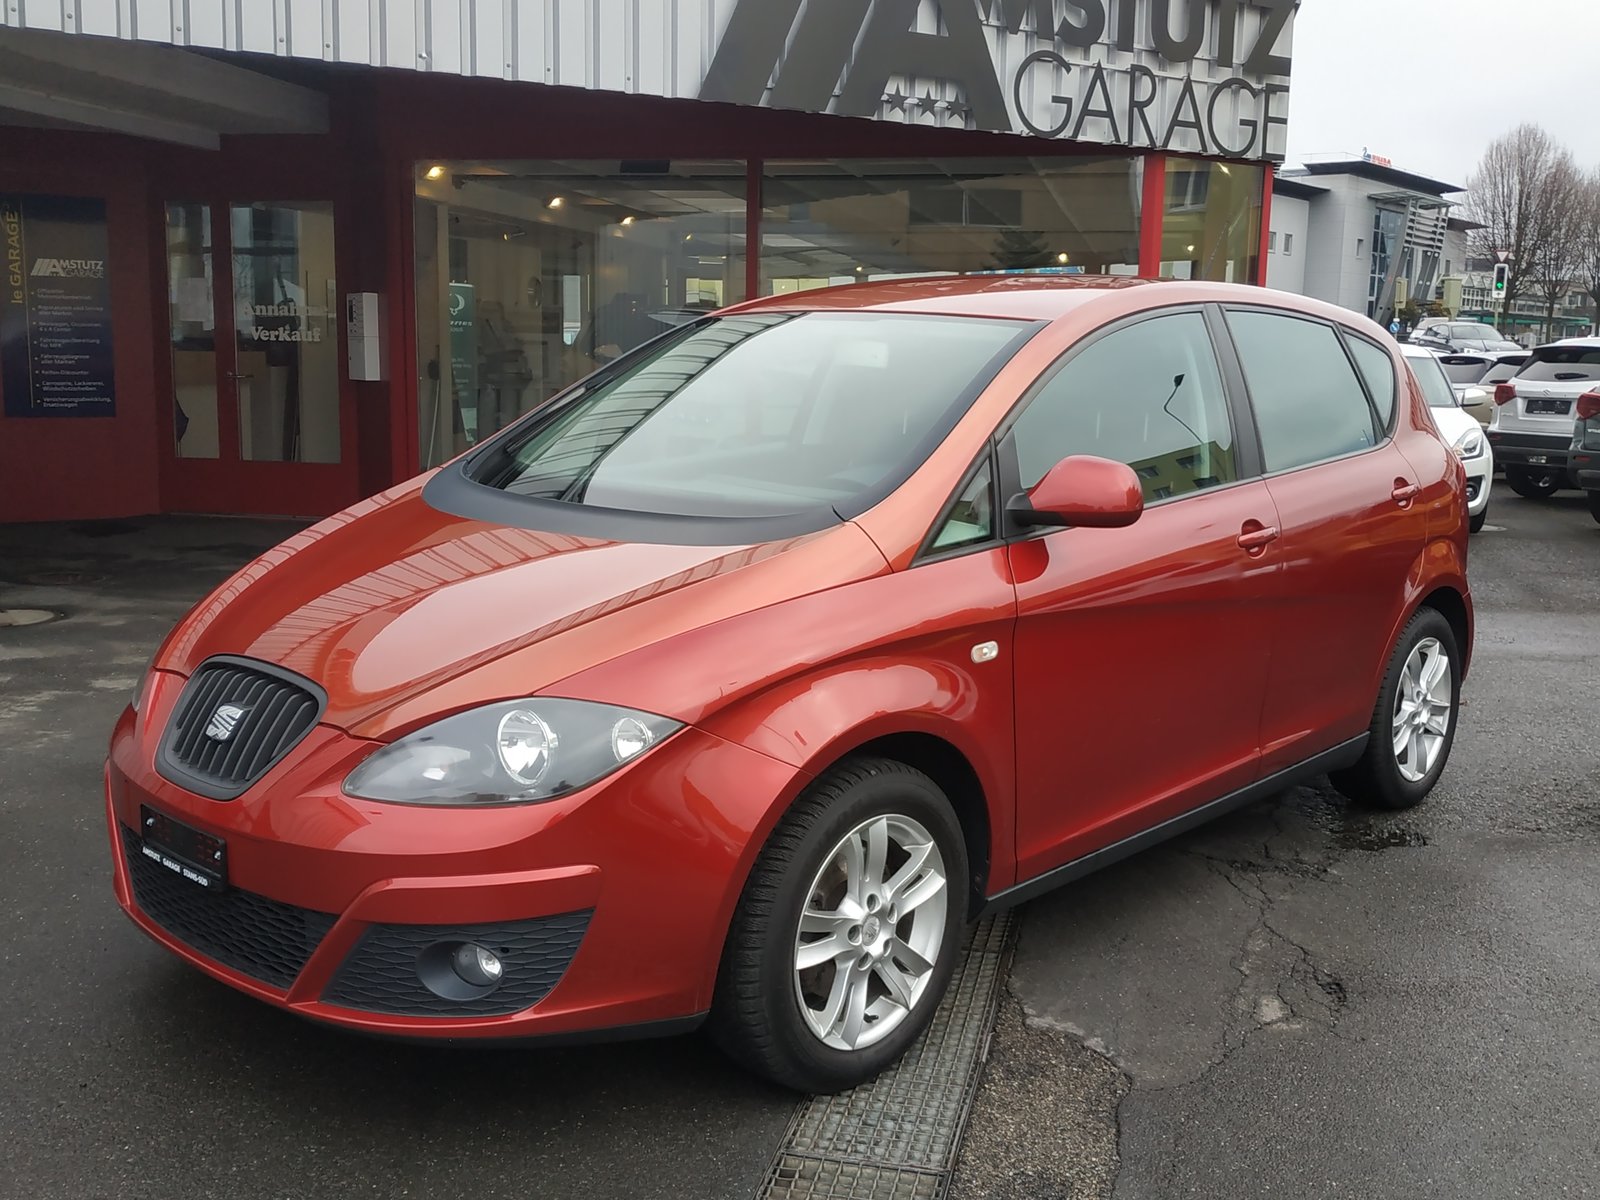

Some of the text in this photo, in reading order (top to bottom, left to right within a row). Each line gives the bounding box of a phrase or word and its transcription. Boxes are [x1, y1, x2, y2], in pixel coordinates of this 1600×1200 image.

[1013, 49, 1290, 161] GARAGE
[6, 211, 24, 304] le GARAGE
[44, 258, 104, 277] AMSTUTZ
[250, 326, 321, 342] Verkauf
